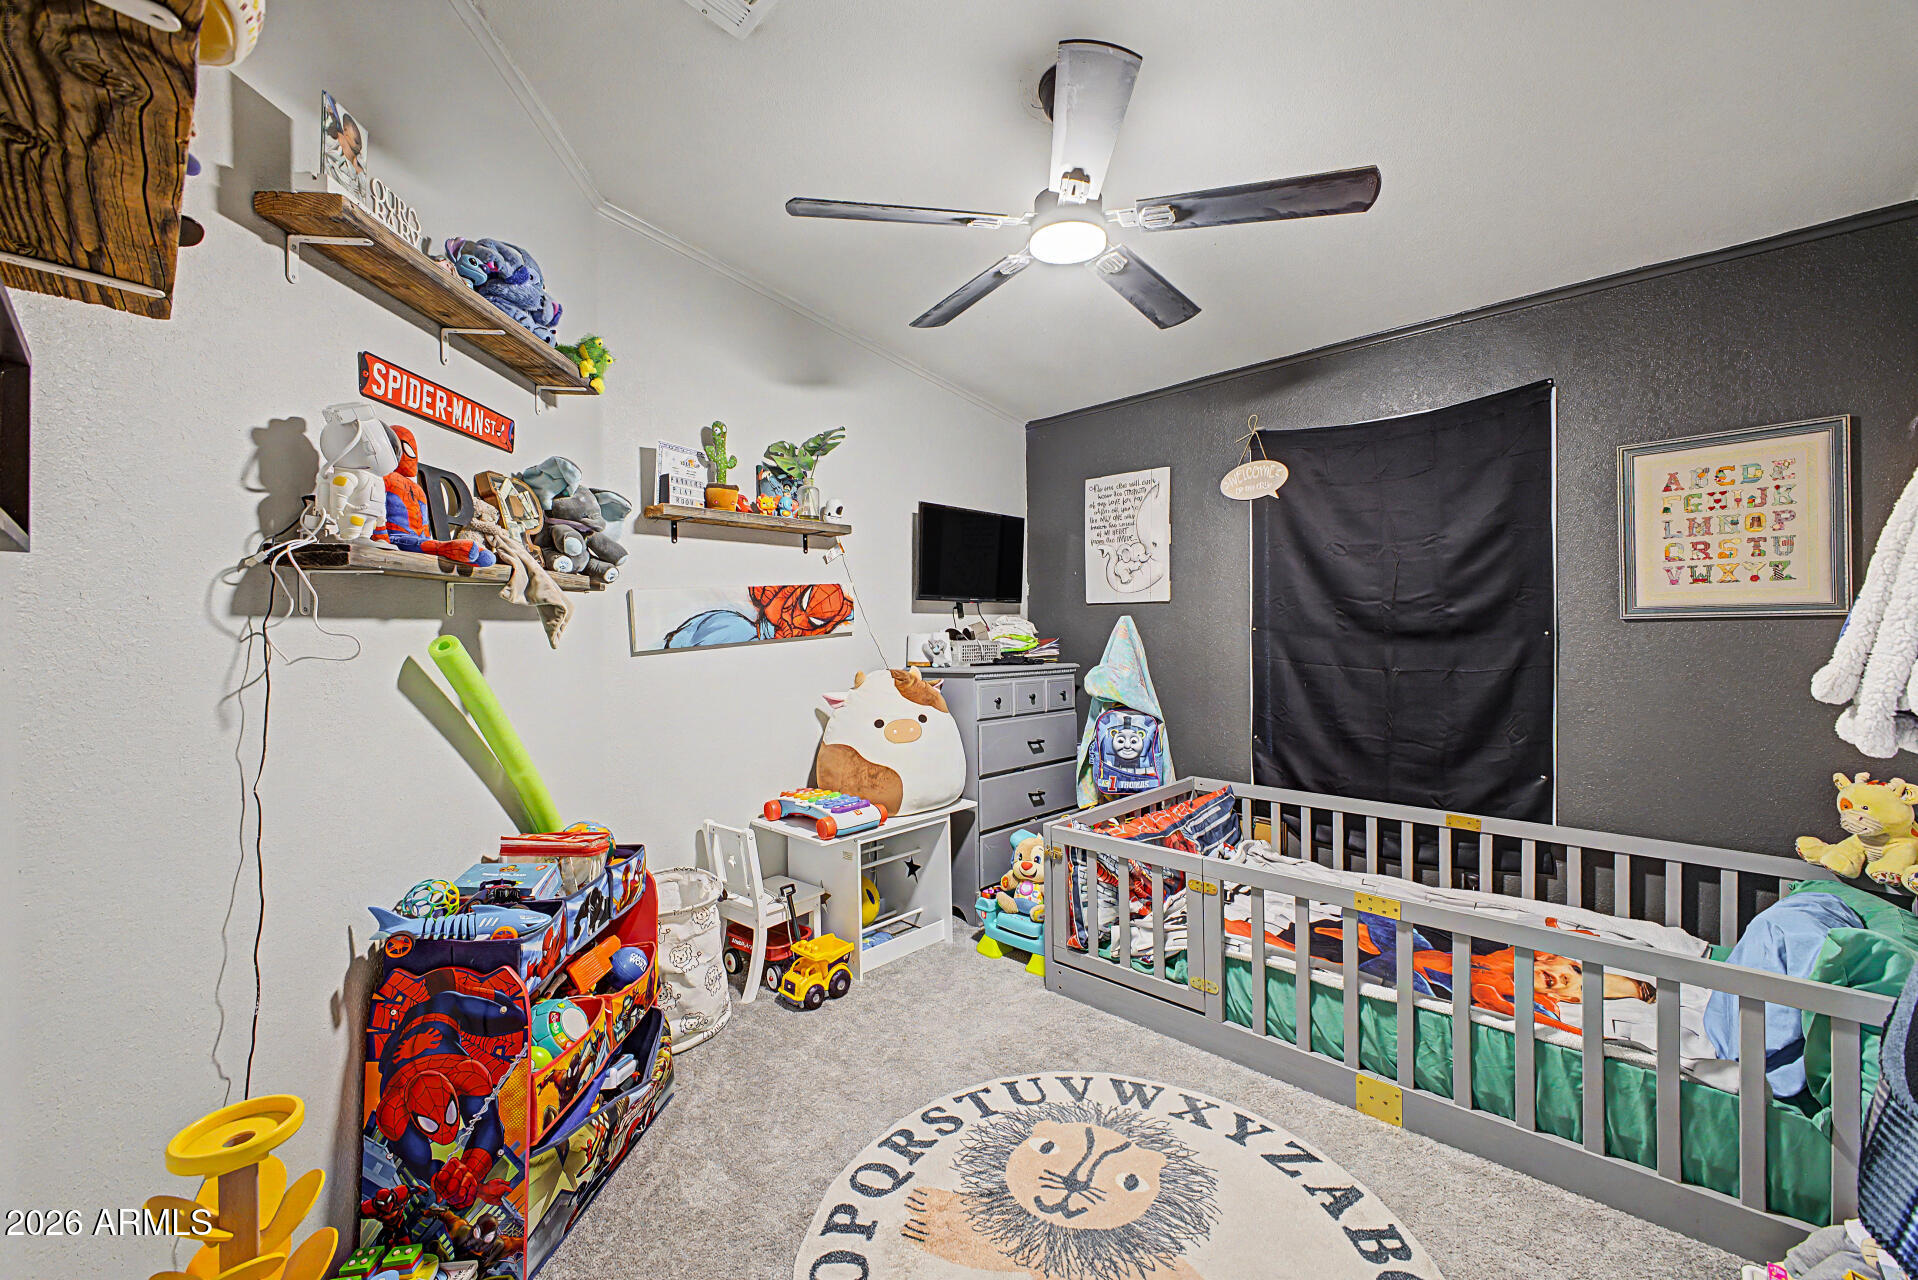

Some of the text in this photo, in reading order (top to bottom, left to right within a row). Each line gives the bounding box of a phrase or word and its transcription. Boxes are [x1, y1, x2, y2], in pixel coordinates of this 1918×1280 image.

[372, 362, 484, 436] SPIDER-MAN
[1228, 464, 1275, 487] WELCOME
[1120, 780, 1150, 789] THOMAS
